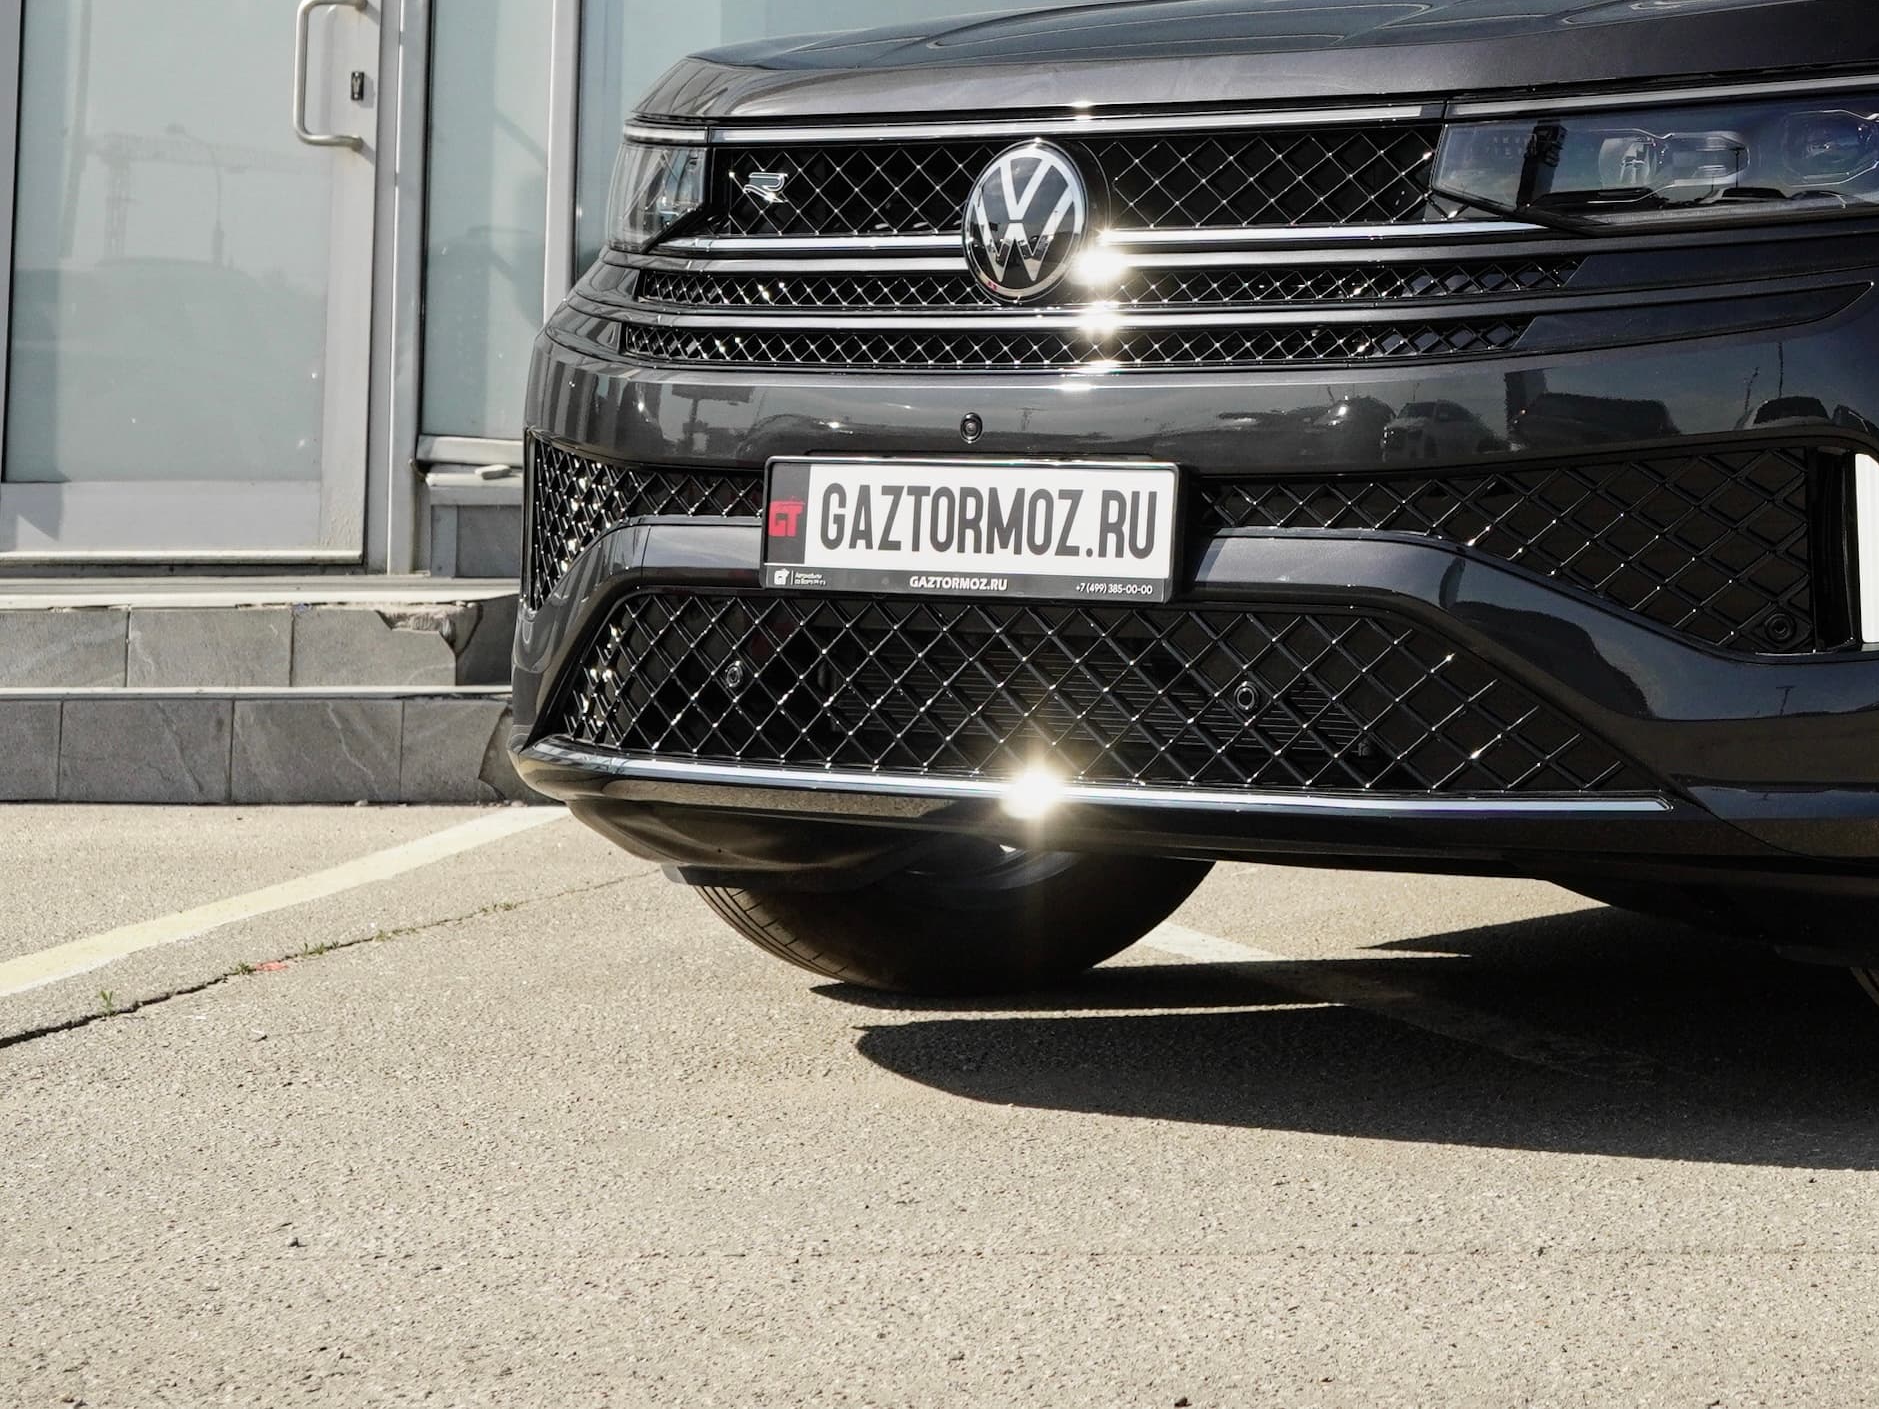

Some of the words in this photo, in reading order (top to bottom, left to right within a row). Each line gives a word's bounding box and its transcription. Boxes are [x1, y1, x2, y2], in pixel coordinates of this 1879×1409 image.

[820, 482, 1157, 559] GAZTORMOZ.RU
[909, 575, 1008, 591] GAZTORMOZ.RU
[1085, 583, 1107, 593] (499)
[1107, 584, 1153, 595] 385-00-00
